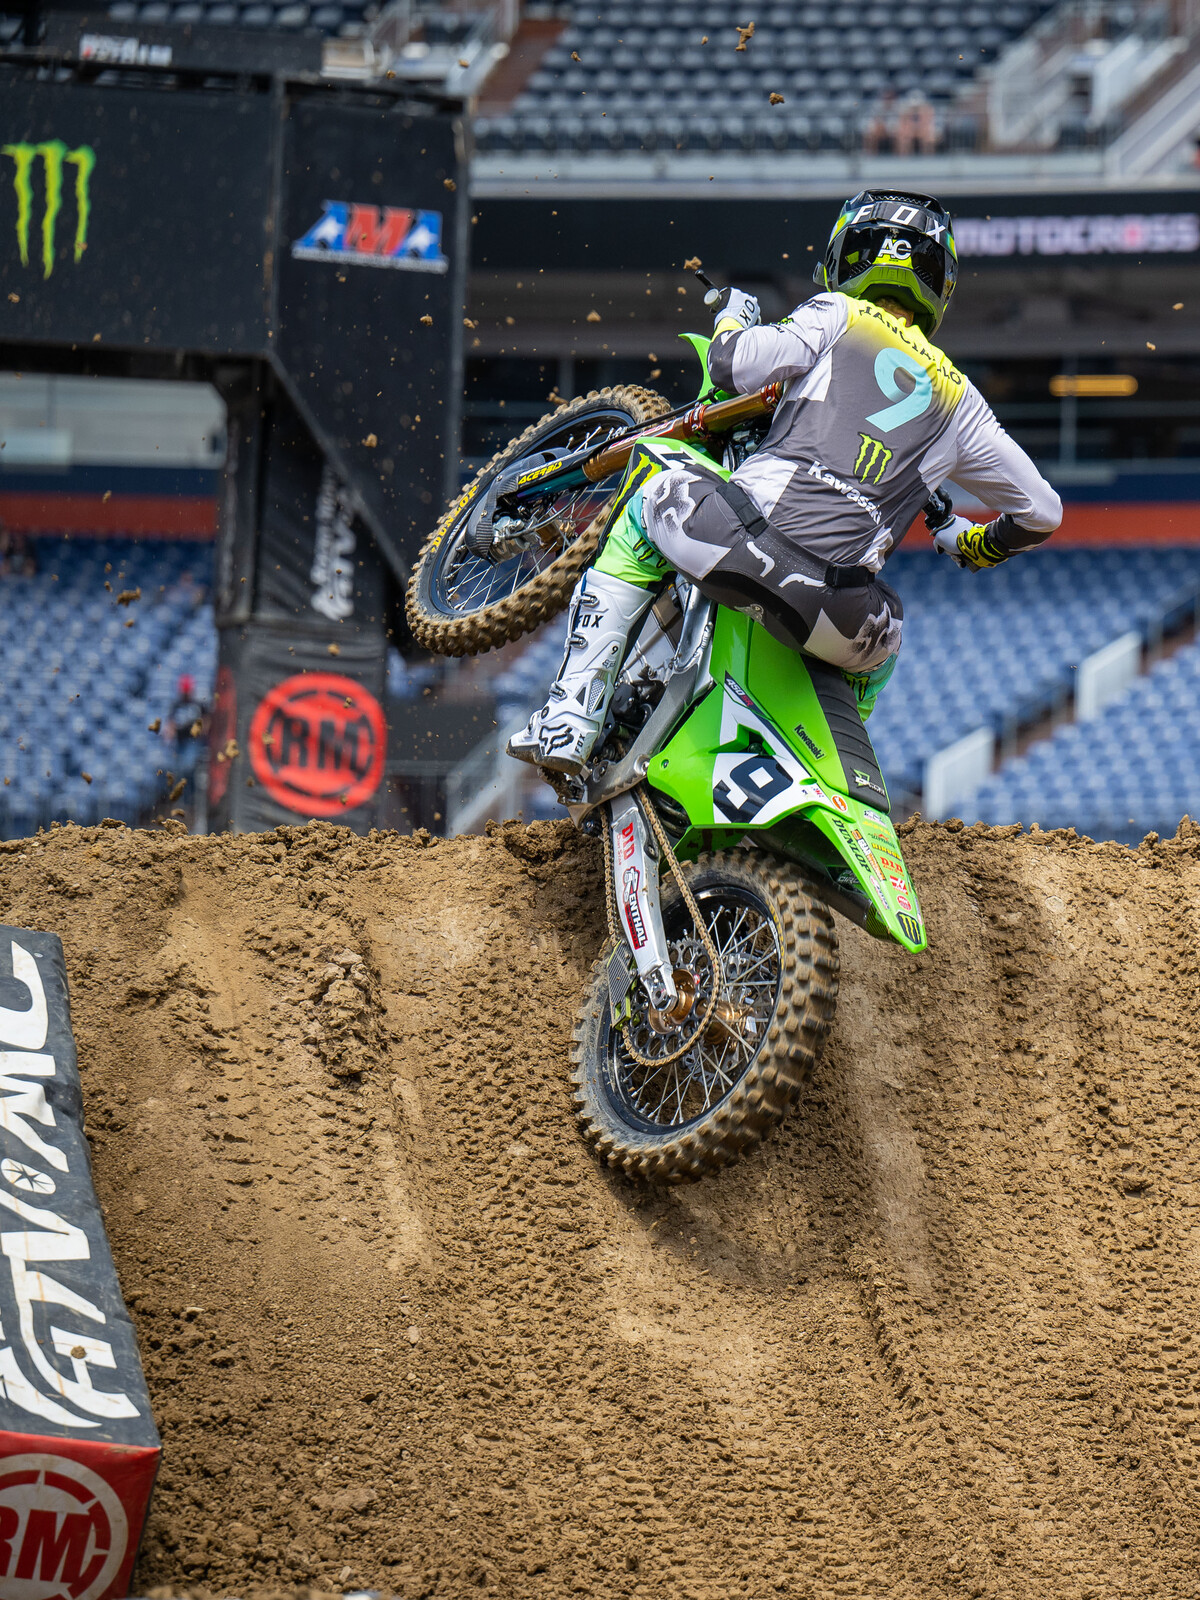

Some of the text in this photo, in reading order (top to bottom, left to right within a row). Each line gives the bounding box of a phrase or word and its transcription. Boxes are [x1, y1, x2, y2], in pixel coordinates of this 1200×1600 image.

[297, 199, 444, 258] AMA
[850, 204, 946, 243] FOX
[877, 238, 912, 260] AC
[865, 347, 933, 433] 9
[807, 460, 882, 526] Kawasaki
[433, 486, 479, 548] DUNLOP
[577, 614, 605, 628] FOX
[611, 645, 620, 655] 9
[576, 734, 586, 754] FOX
[794, 724, 825, 760] Kawasaki
[713, 755, 794, 824] 9
[622, 822, 635, 860] DID
[832, 818, 871, 873] DUNLOP
